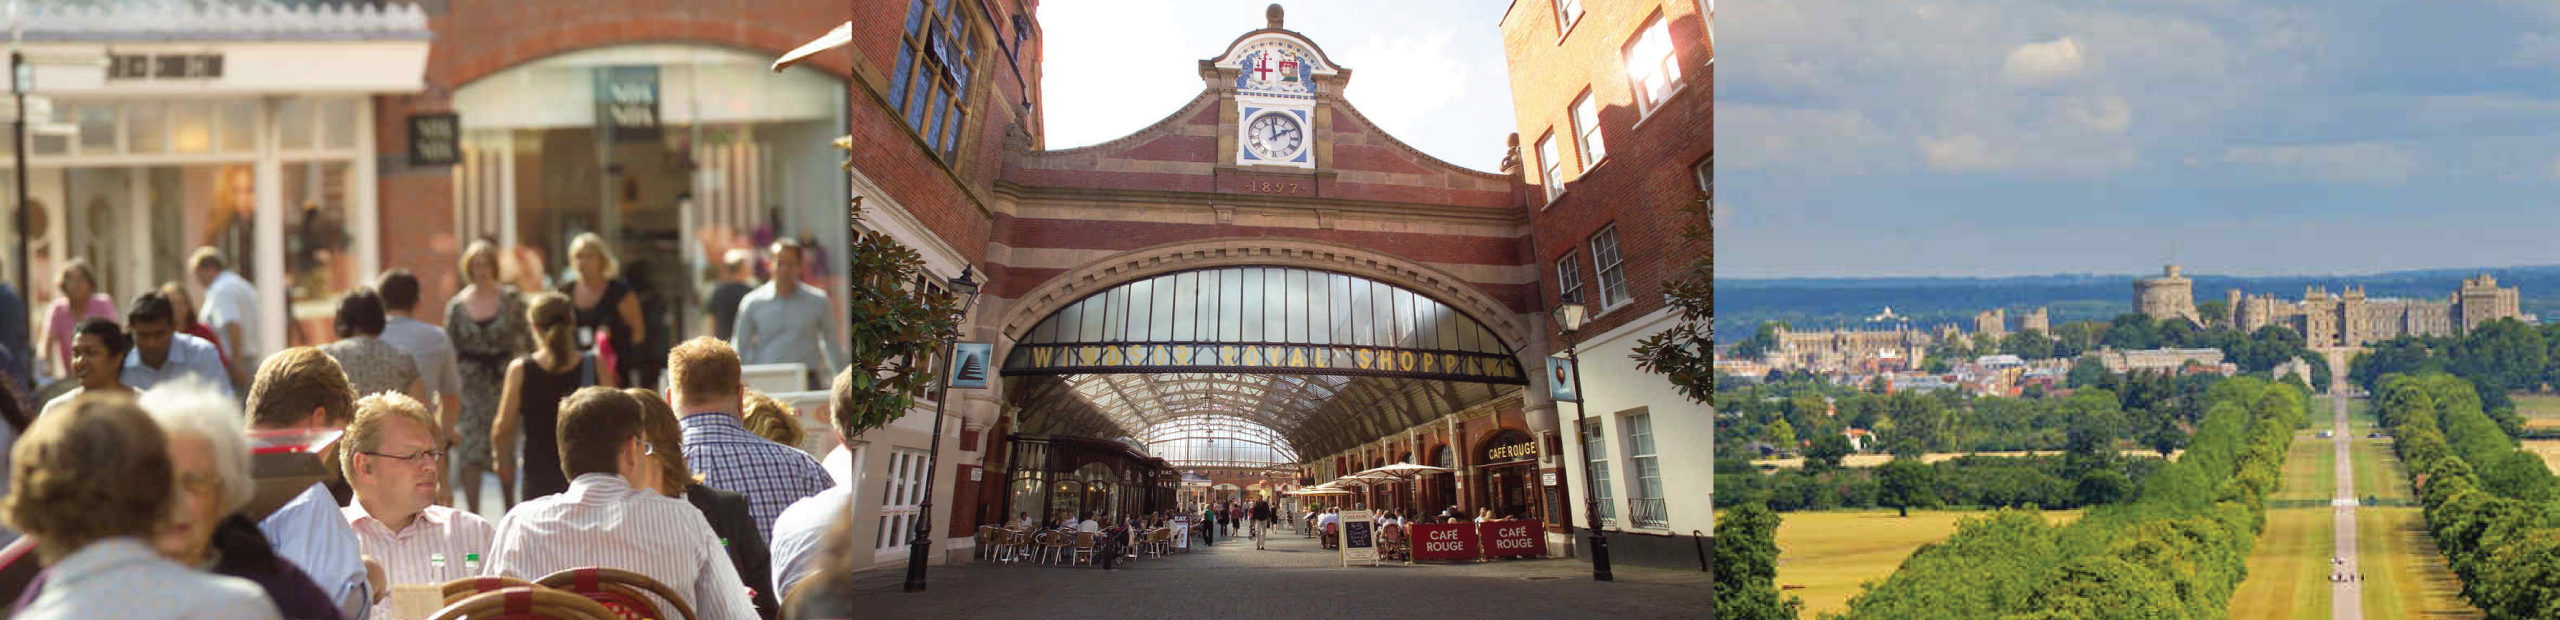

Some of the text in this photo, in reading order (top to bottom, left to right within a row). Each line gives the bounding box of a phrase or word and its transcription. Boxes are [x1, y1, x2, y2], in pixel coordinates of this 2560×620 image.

[1250, 181, 1300, 194] 1897
[1033, 345, 1516, 377] WINDSOR ROYAL SHOPPING
[1489, 441, 1537, 460] CAFÉ ROUGE
[1429, 528, 1458, 540] CAFÉ
[1499, 526, 1527, 537] CAFÉ
[1426, 541, 1464, 552] ROUGE
[1496, 538, 1533, 549] ROUGE
